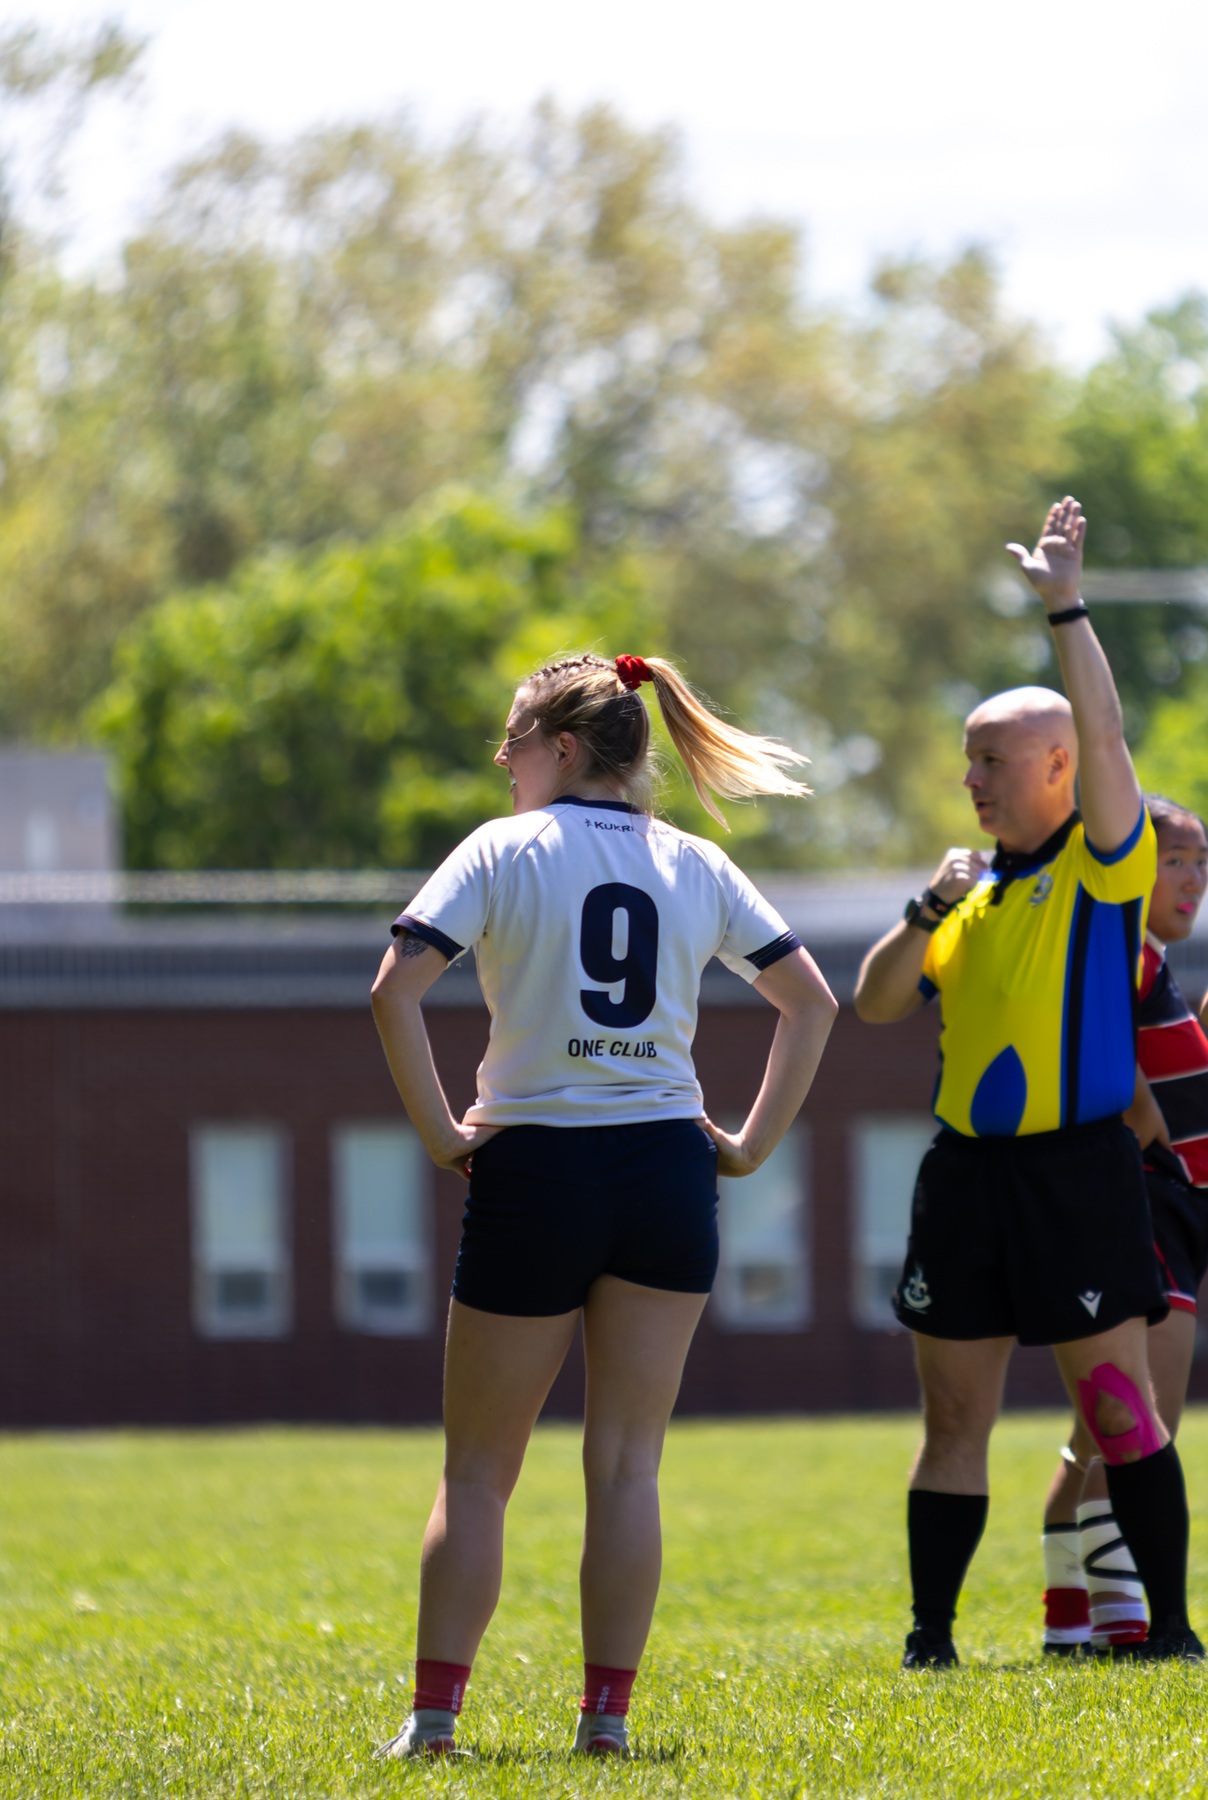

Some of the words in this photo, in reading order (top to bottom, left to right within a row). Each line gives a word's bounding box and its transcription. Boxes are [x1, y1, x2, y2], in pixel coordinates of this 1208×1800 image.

[594, 821, 634, 833] KUKRI
[580, 882, 659, 1029] 9
[568, 1038, 606, 1058] ONE
[609, 1040, 657, 1058] CLUB
